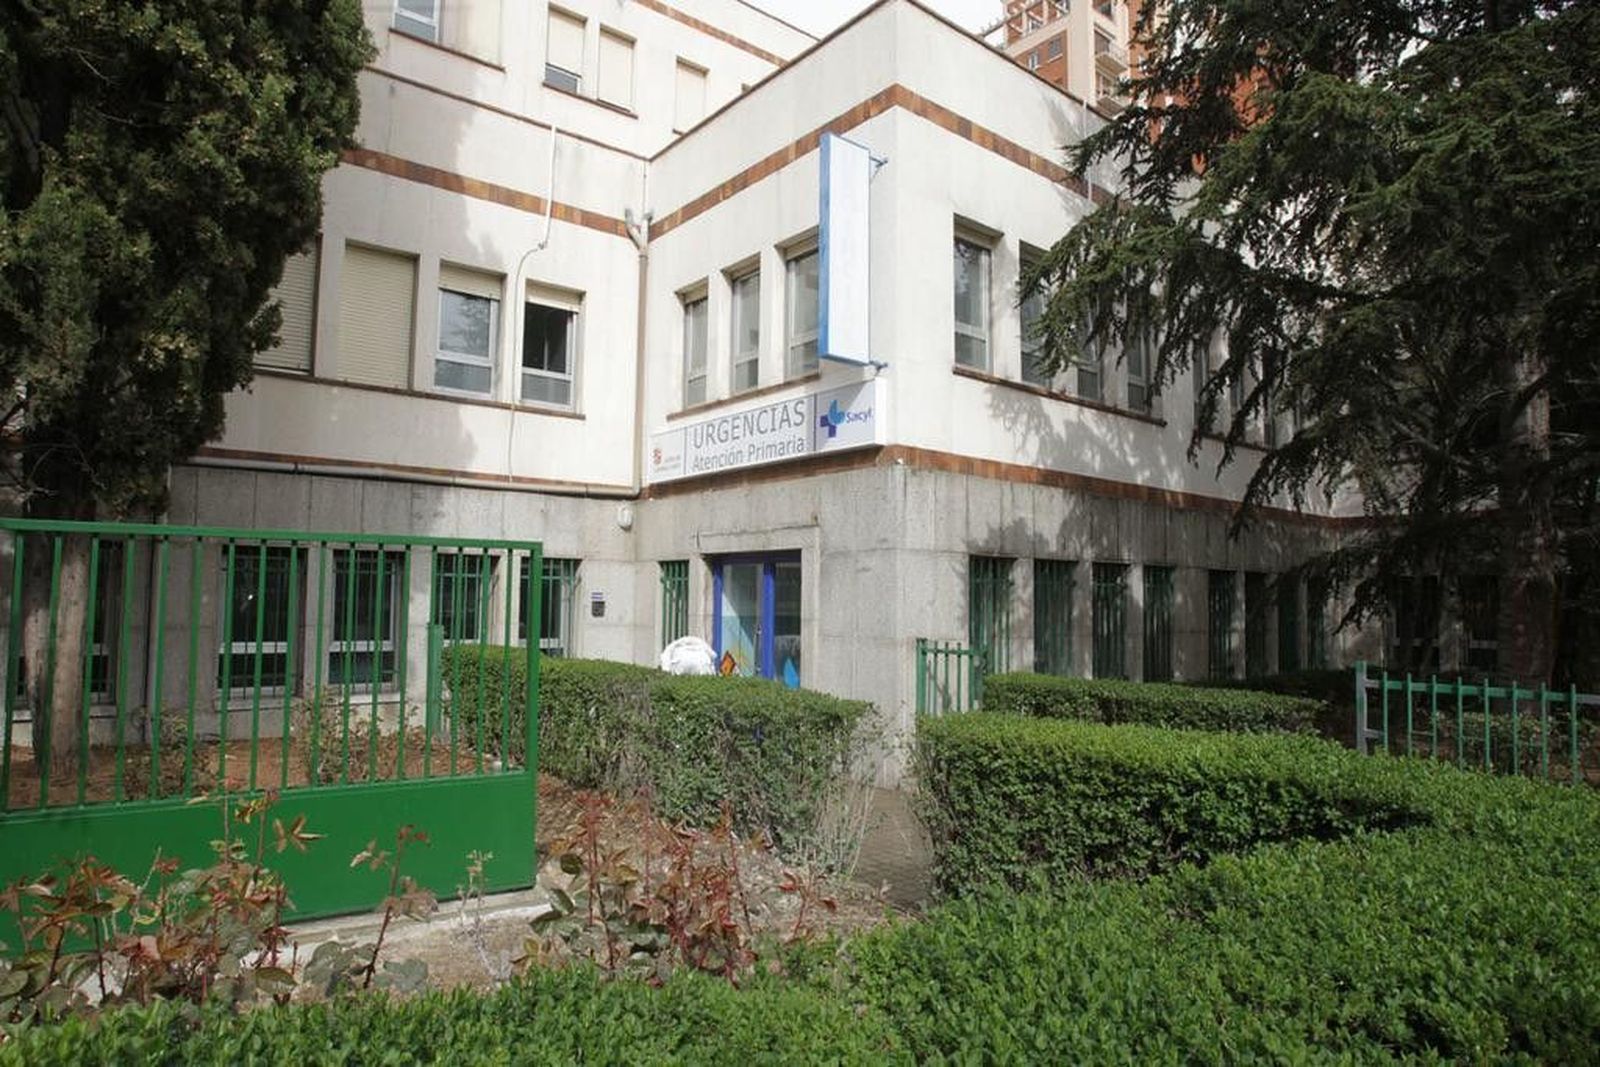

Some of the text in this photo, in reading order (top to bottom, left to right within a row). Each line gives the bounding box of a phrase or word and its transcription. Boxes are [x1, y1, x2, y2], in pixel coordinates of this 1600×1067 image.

[693, 400, 805, 448] URGENCIAS
[692, 435, 805, 472] Atención Primaria
